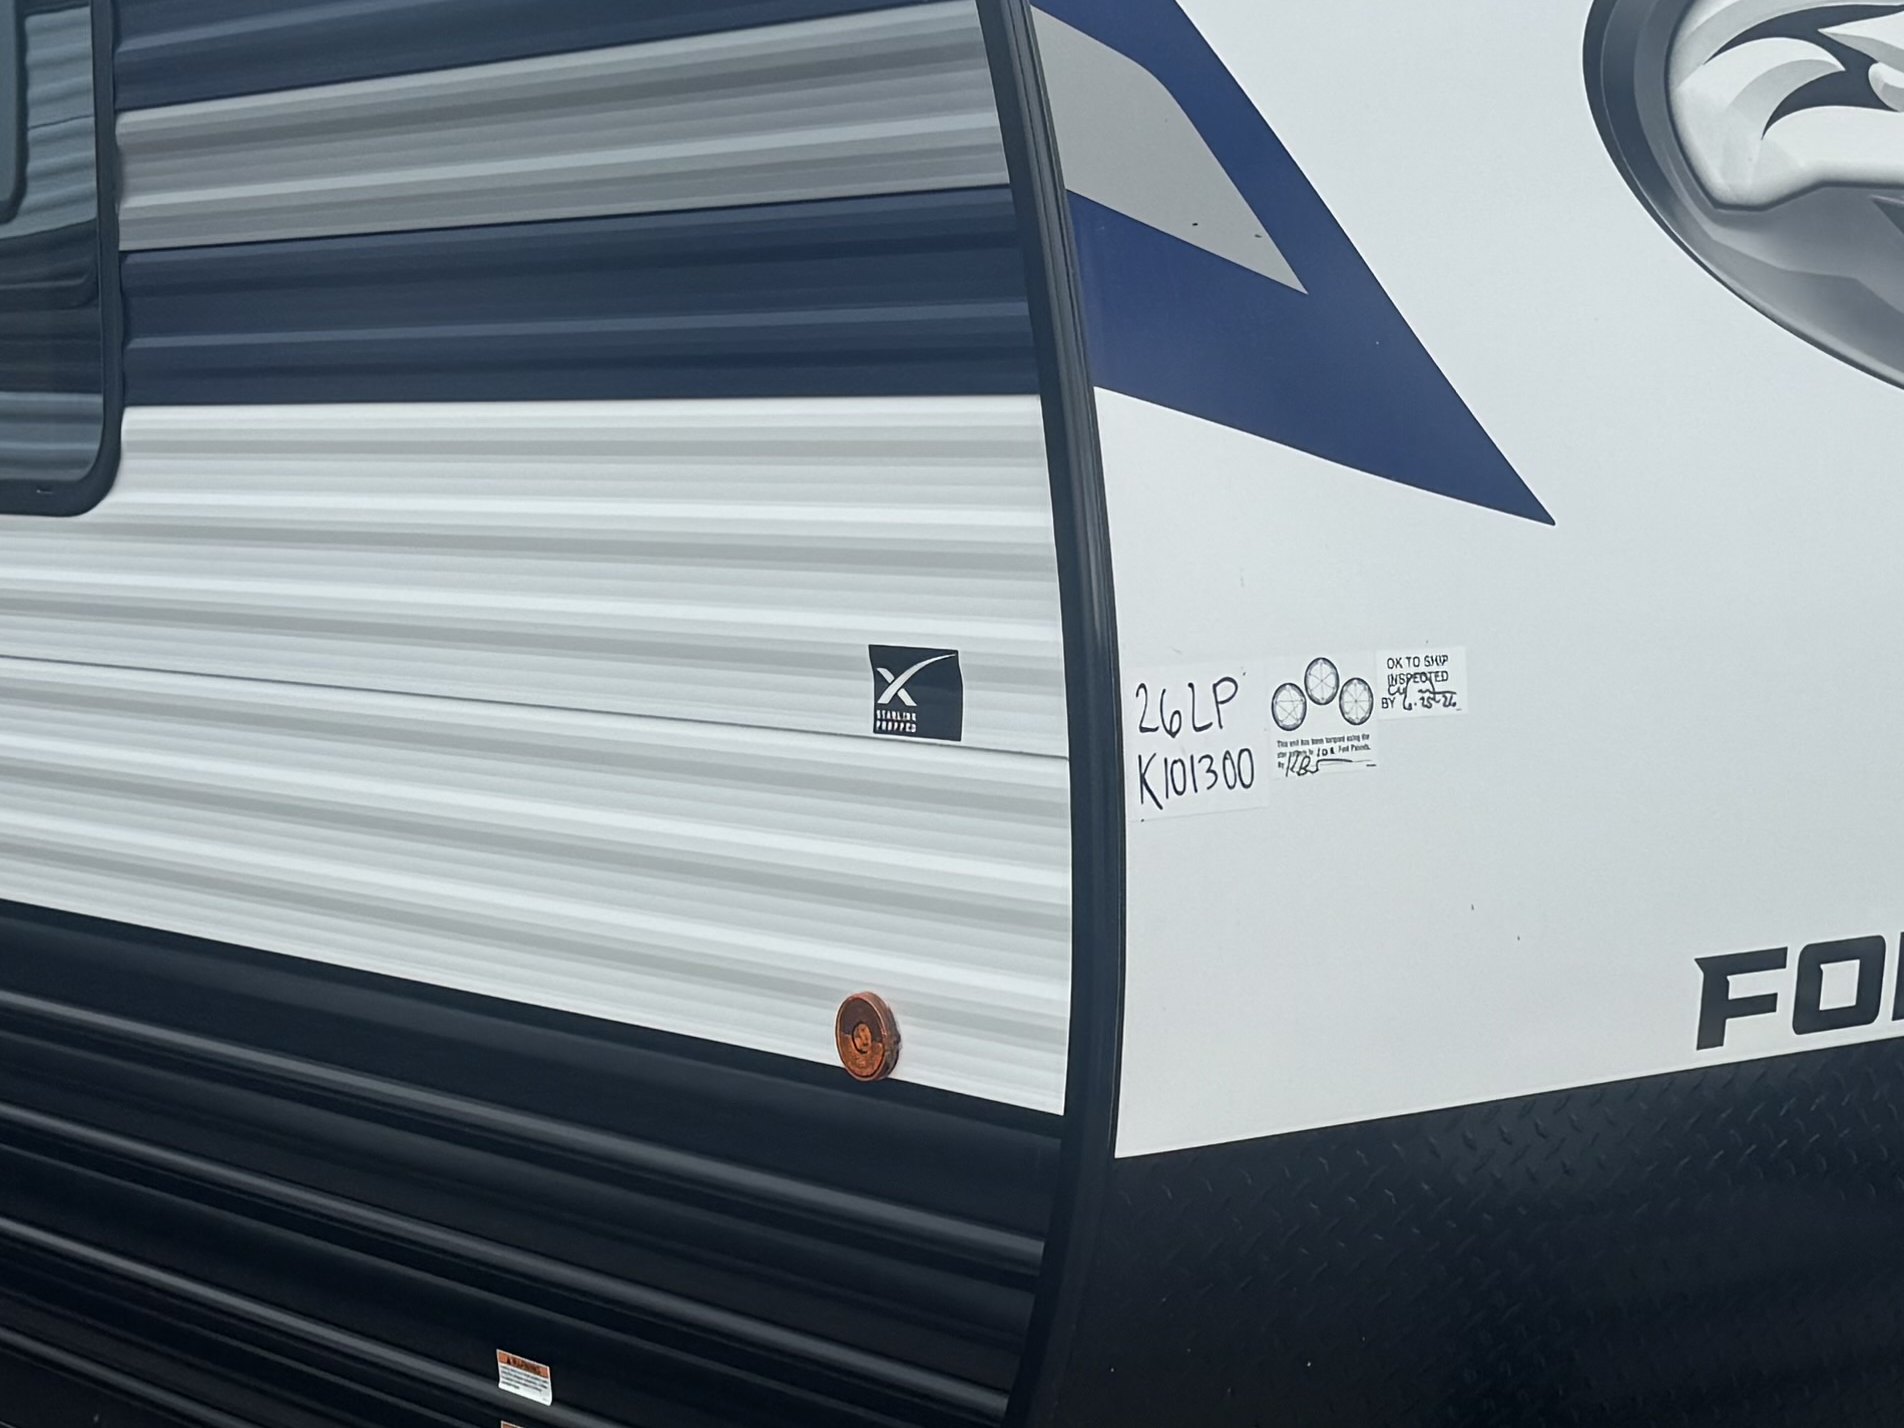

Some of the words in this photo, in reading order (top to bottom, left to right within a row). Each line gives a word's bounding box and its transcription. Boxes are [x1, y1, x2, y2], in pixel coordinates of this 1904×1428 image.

[1387, 657, 1403, 669] OK
[1405, 656, 1421, 668] TO
[1382, 697, 1395, 709] BY
[1137, 747, 1255, 810] K101300
